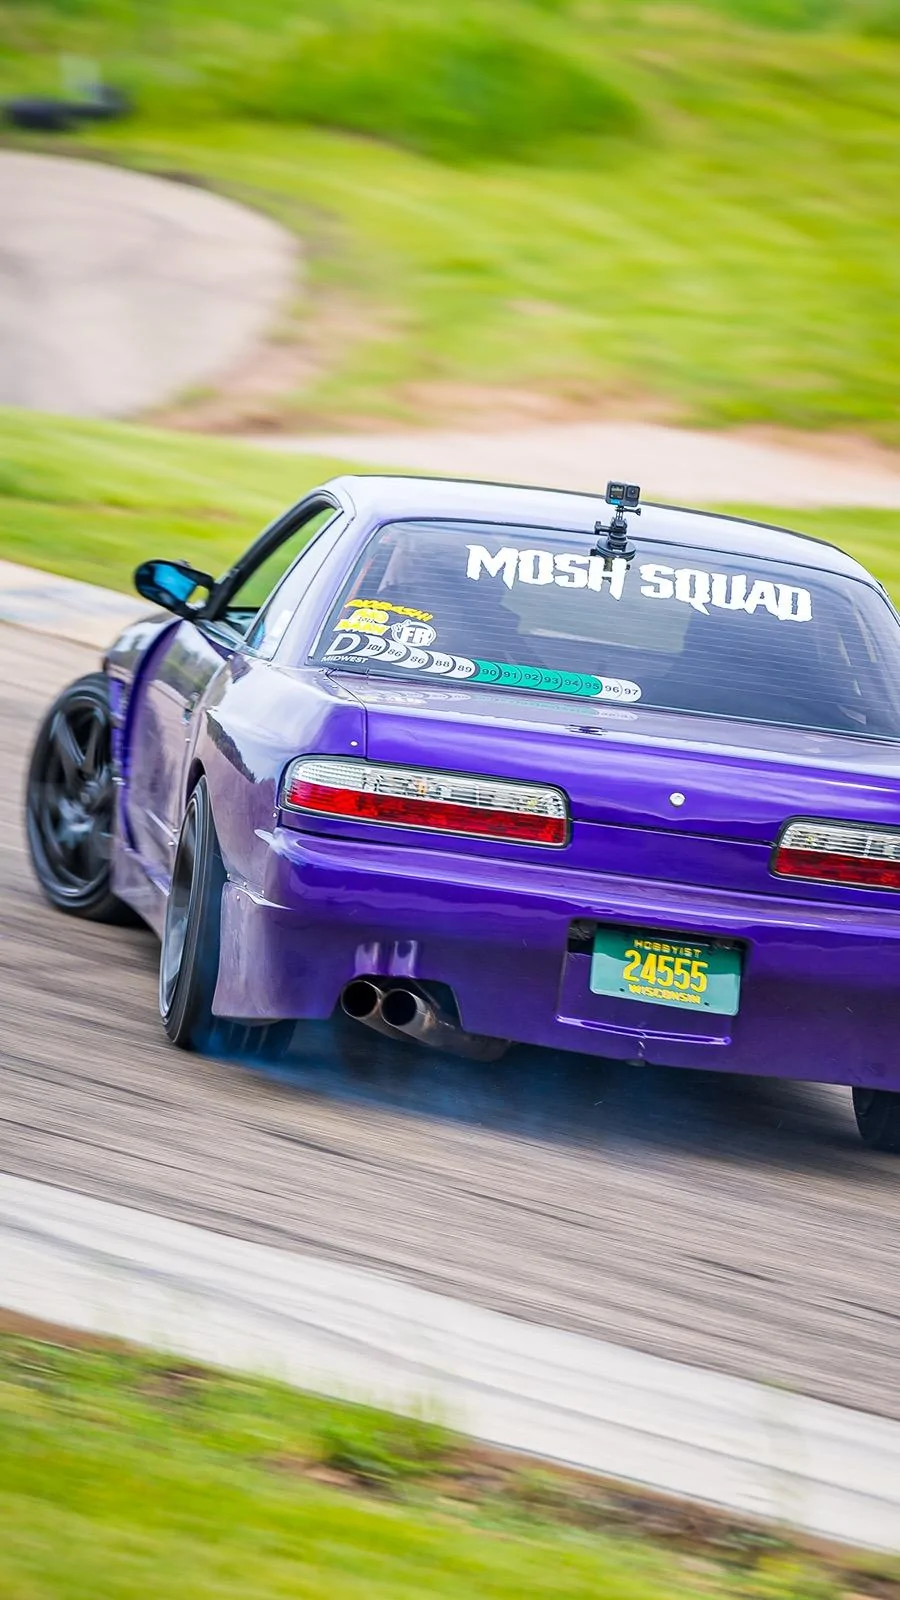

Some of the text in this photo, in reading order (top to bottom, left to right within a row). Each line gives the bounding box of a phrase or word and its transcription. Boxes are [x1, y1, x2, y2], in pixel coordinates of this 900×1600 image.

[465, 545, 813, 623] MOSH SQUAD
[320, 655, 368, 664] MIDWEST
[435, 659, 450, 668] 88
[457, 664, 472, 673] 89
[482, 668, 497, 677] 90
[503, 671, 517, 680] 91
[524, 673, 539, 681] 92
[544, 676, 559, 685] 93
[564, 679, 579, 687] 94
[585, 681, 600, 690] 95
[604, 685, 620, 694] 96
[624, 687, 639, 696] 97
[633, 939, 702, 958] HOBBYIST
[622, 949, 709, 993] 24555
[628, 983, 701, 1004] WISCONSIN
